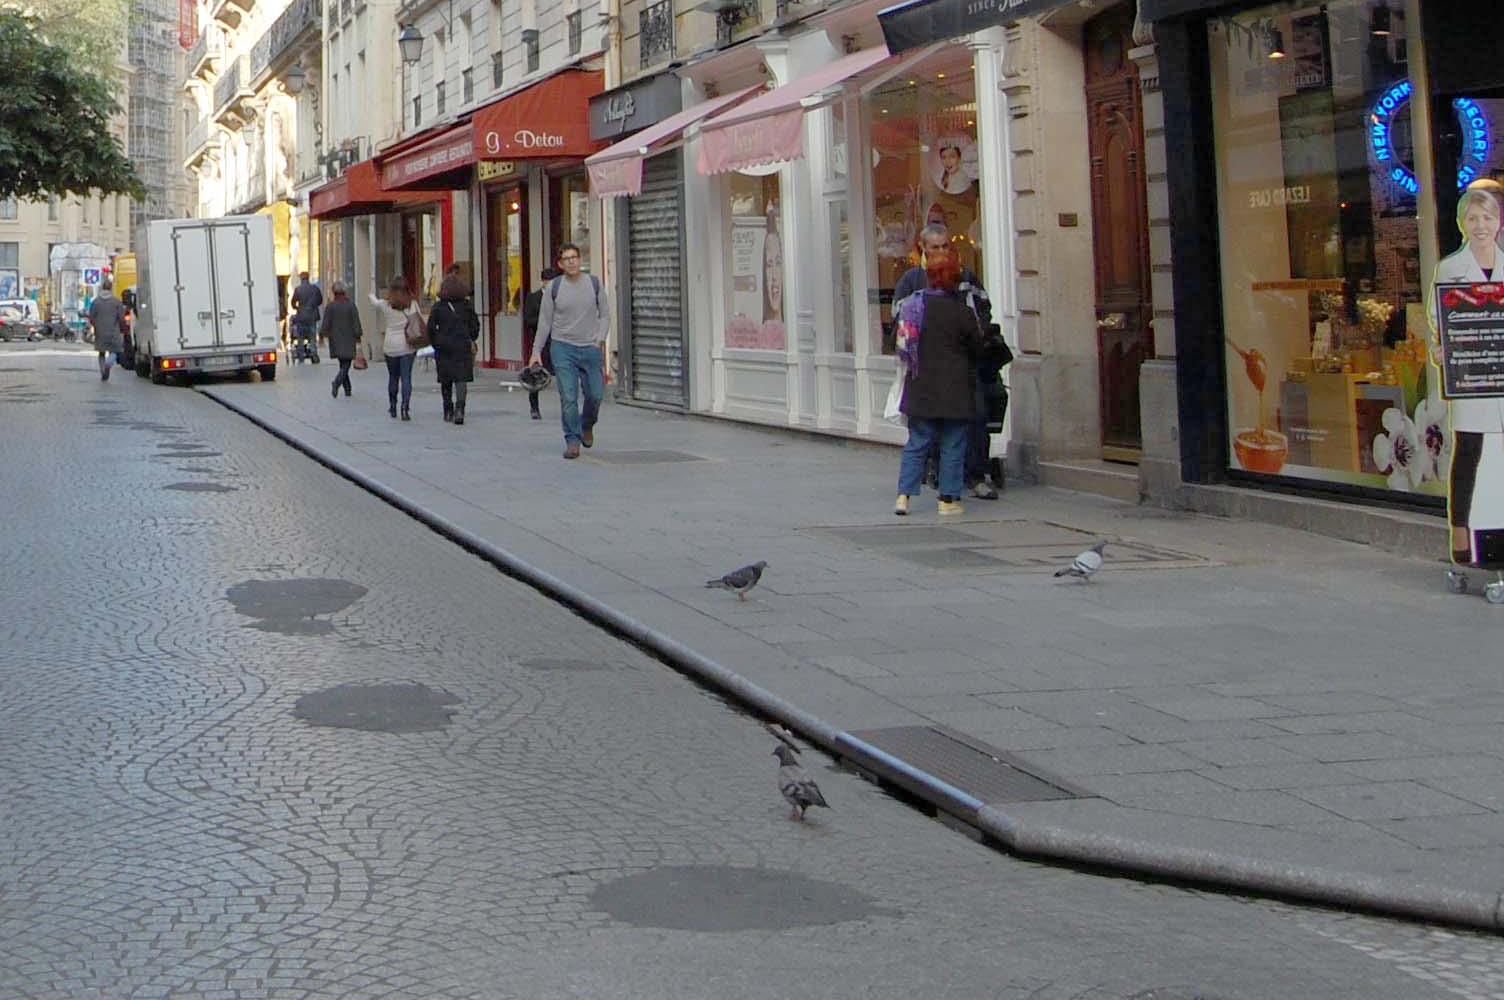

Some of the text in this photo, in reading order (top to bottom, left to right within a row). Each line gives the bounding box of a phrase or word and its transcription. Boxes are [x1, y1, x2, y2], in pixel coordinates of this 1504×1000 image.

[1371, 82, 1488, 163] NEW YORK HECARY
[514, 130, 564, 148] Detou
[1391, 168, 1419, 193] SIN
